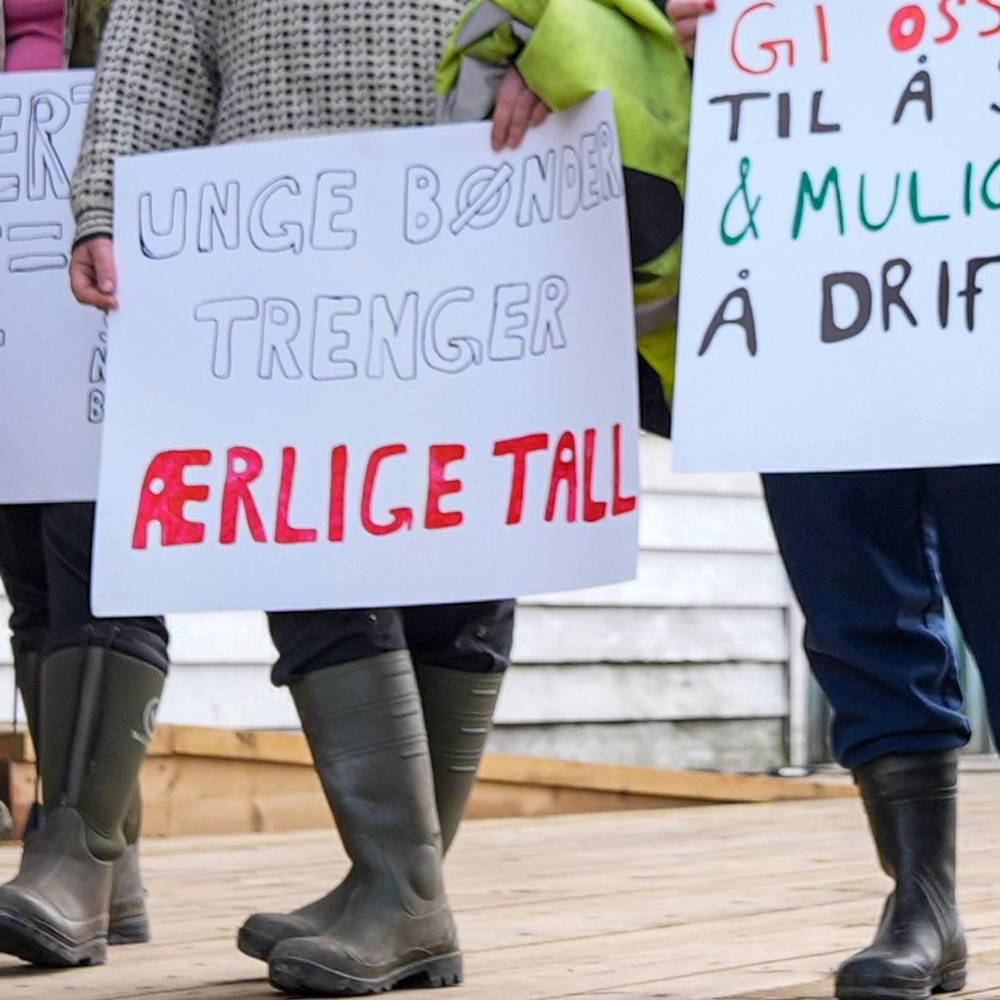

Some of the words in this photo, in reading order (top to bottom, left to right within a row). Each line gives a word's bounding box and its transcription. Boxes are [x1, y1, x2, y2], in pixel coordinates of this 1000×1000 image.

[731, 2, 829, 75] GI
[709, 90, 841, 142] TIL
[893, 54, 934, 125] Å
[138, 169, 358, 260] UNGE
[402, 121, 623, 245] BØNDER
[719, 157, 762, 246] &
[194, 275, 570, 381] TRENGER
[698, 268, 758, 357] Å
[131, 443, 466, 550] ÆRLIGE
[493, 423, 637, 526] TALL
